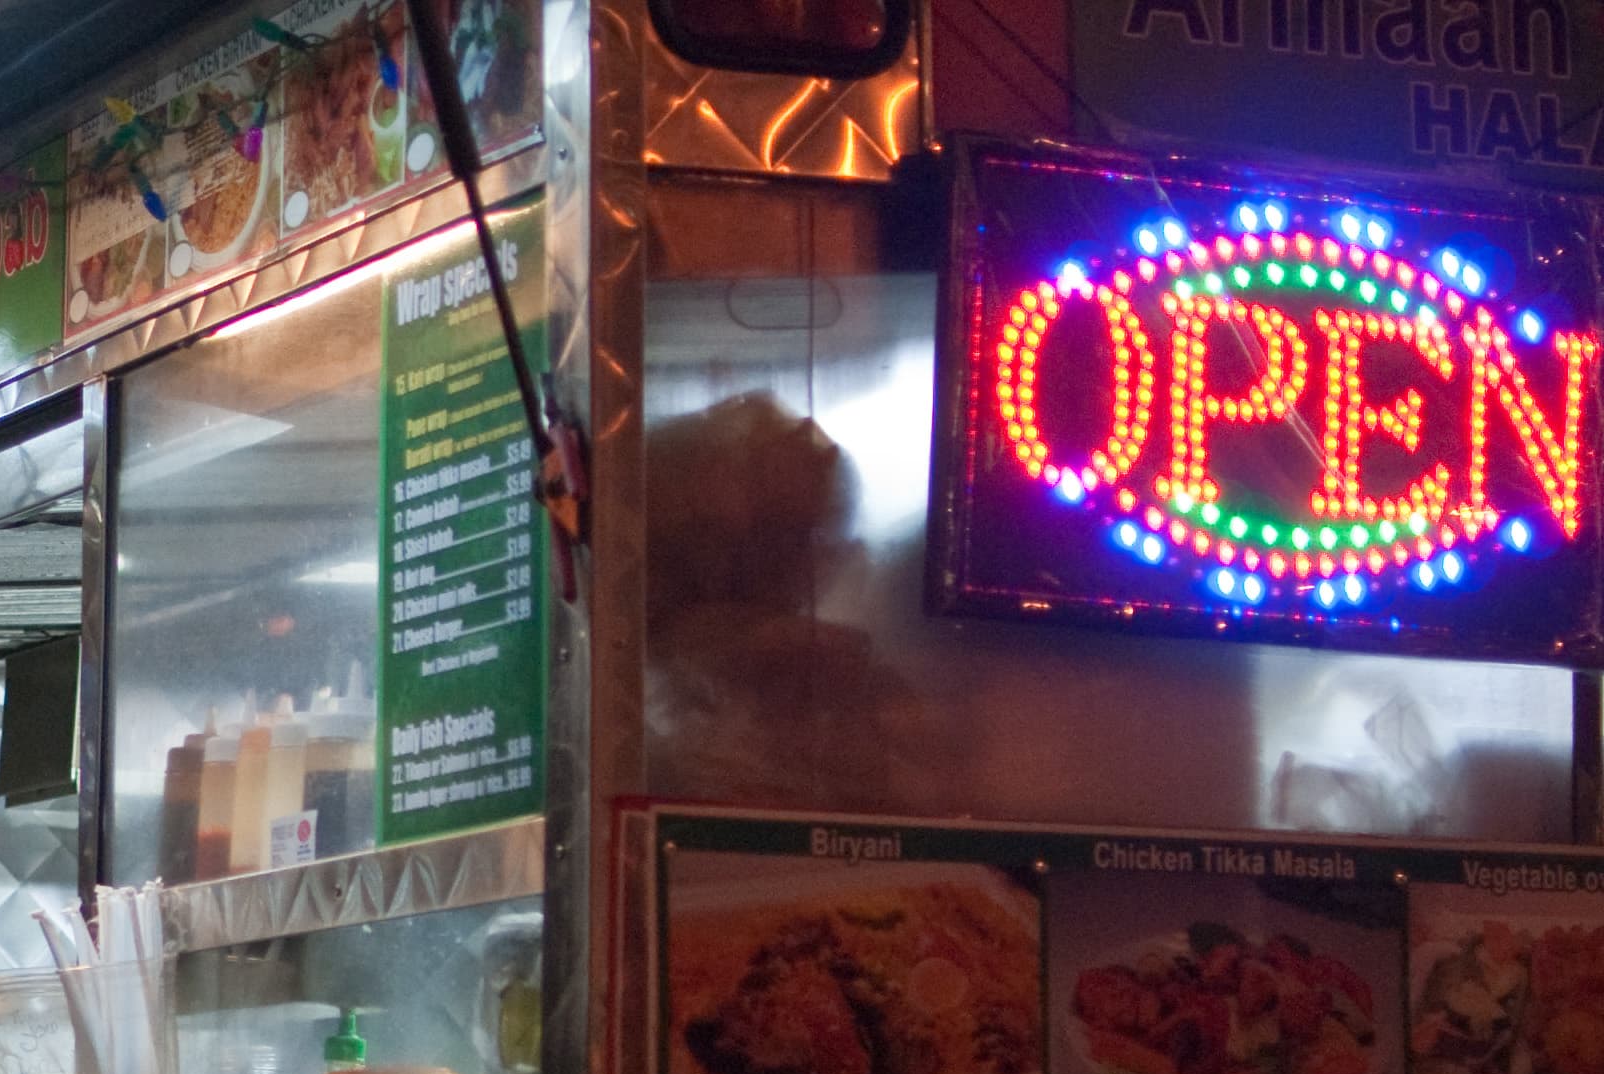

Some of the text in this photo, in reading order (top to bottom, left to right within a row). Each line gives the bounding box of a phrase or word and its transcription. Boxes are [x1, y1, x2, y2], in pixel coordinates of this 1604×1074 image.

[1410, 80, 1604, 168] HAL
[396, 274, 442, 327] Wrap
[444, 239, 518, 308] specls
[996, 283, 1601, 542] OPEN
[812, 826, 901, 867] Biryani
[1093, 841, 1356, 879] Chicken Tikka Masala
[1462, 858, 1604, 894] Vegetable o
